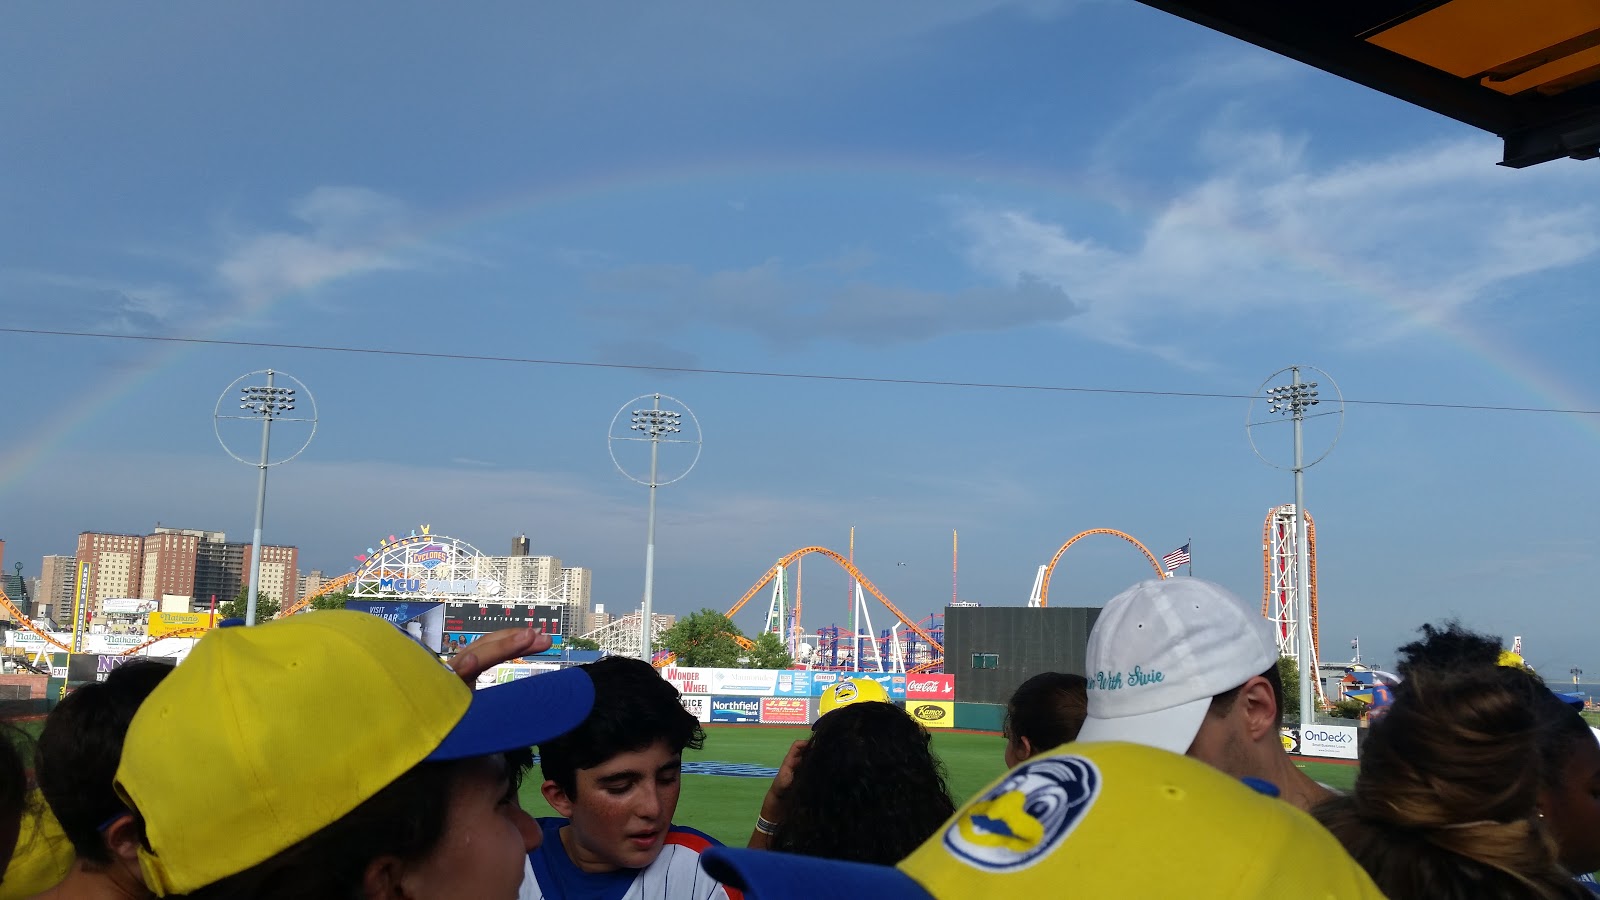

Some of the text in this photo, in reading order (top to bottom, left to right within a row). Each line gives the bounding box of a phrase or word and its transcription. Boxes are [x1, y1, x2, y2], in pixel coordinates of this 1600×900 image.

[413, 550, 447, 563] CYCLONES
[380, 578, 420, 592] MCU
[369, 606, 385, 614] VISIT
[160, 613, 198, 622] Nathan's
[104, 635, 142, 644] Nathan's
[53, 668, 67, 676] EXIT
[1097, 671, 1123, 690] With
[713, 701, 758, 710] Northfield
[1305, 730, 1346, 743] OnDeck
